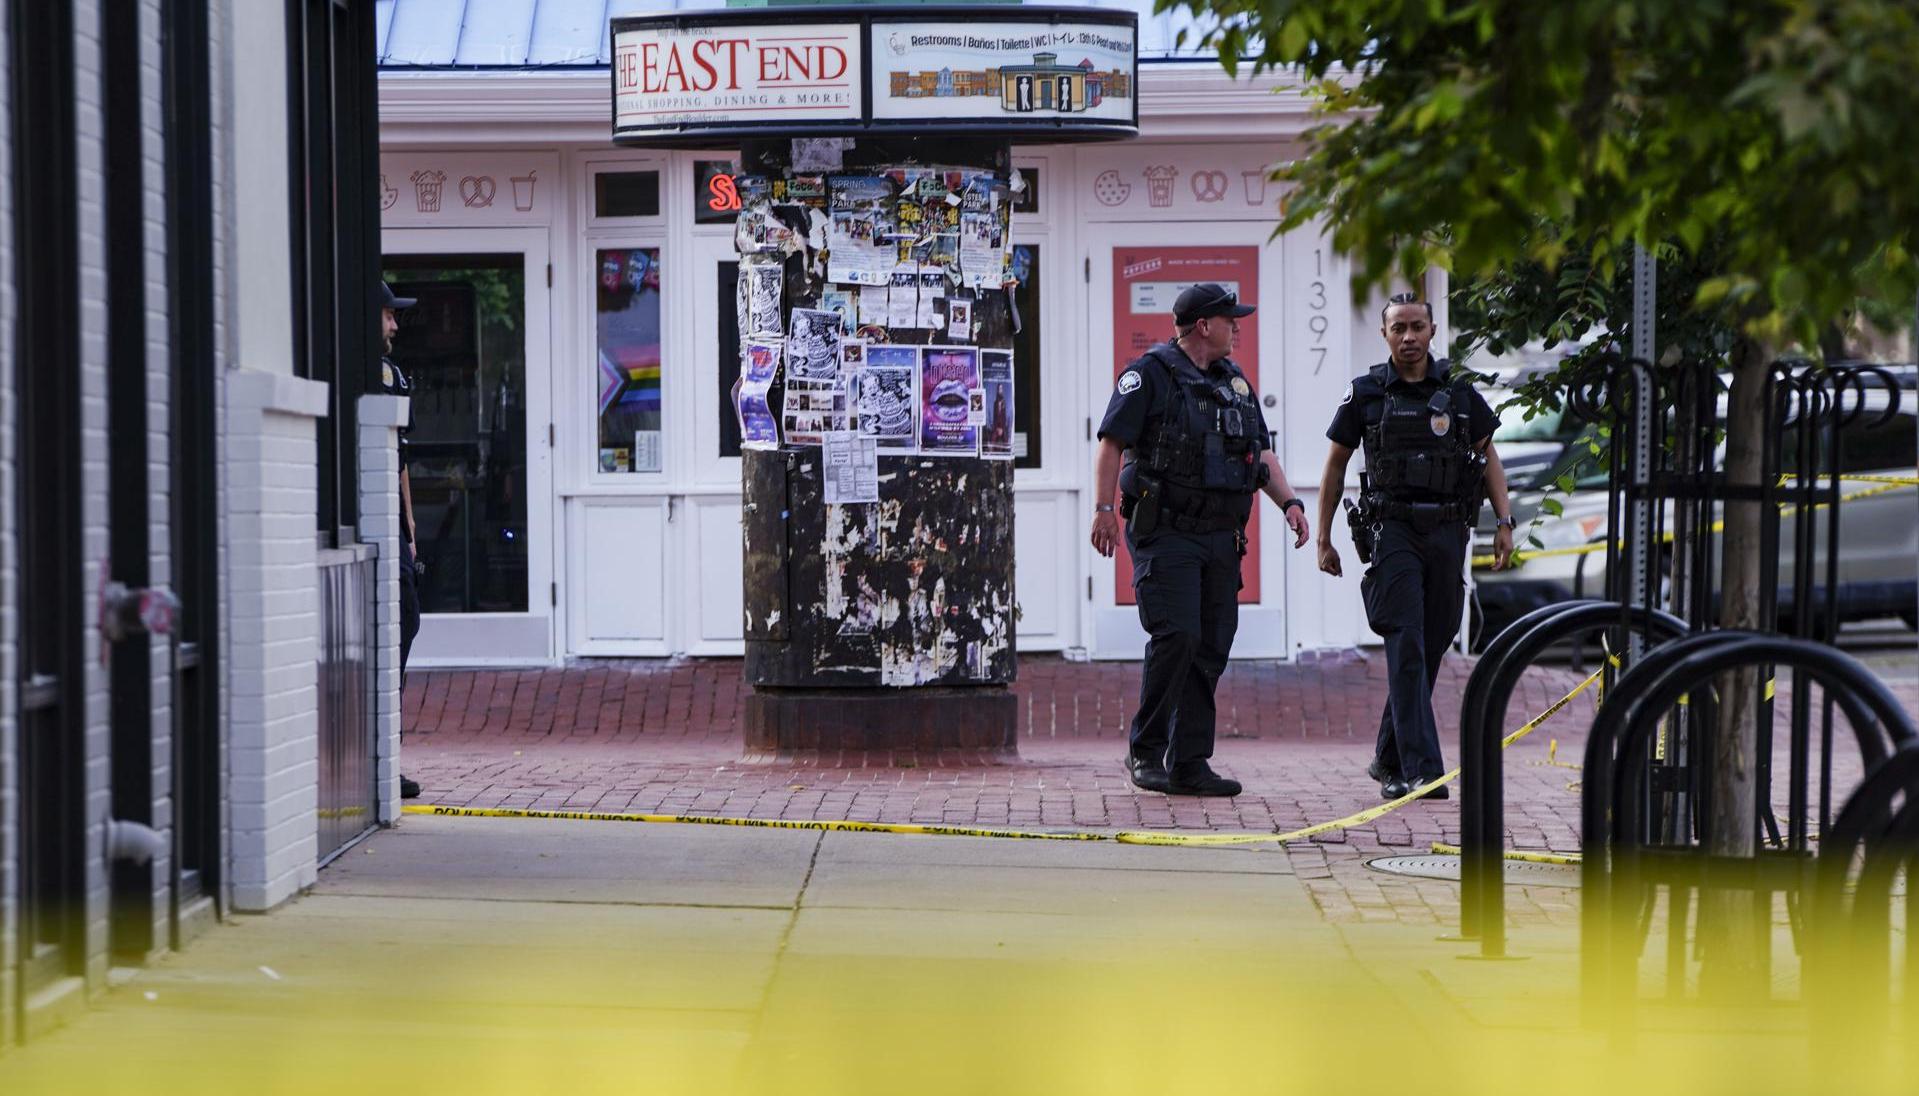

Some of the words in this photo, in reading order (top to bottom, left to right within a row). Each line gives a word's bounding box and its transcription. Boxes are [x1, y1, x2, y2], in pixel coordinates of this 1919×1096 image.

[911, 35, 962, 47] Restrooms
[968, 37, 995, 50] Baños
[1001, 39, 1030, 50] Toilette
[1035, 35, 1046, 47] WC
[641, 39, 750, 94] EAST
[757, 46, 848, 81] END
[715, 95, 768, 106] DINING
[778, 94, 786, 104] &
[797, 93, 850, 104] MORE!
[1309, 248, 1328, 376] 1397
